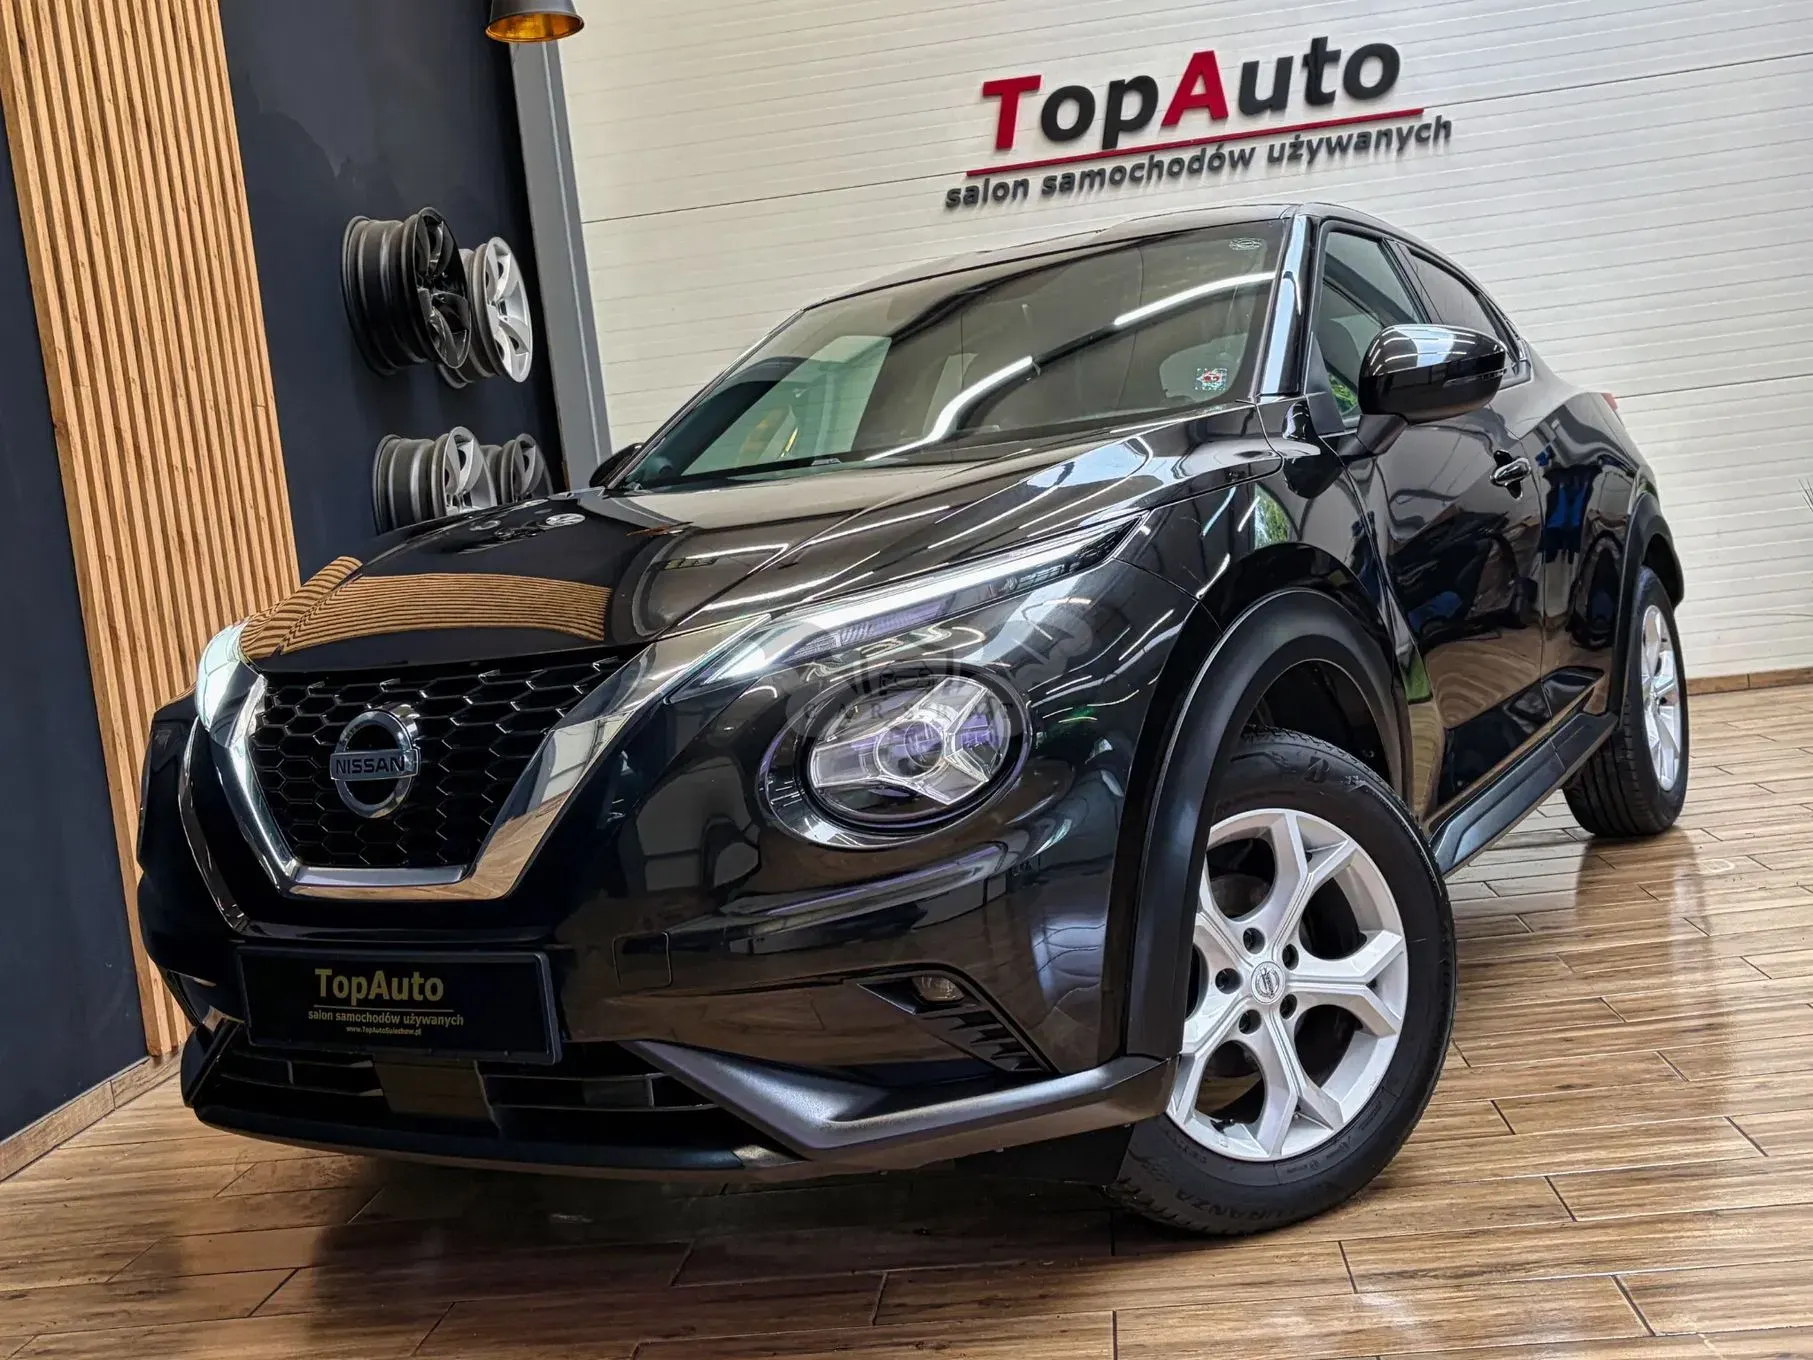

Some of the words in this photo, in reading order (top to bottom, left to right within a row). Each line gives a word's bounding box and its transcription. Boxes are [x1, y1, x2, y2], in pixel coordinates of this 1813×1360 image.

[982, 36, 1401, 151] TopAuto
[945, 177, 1030, 209] salon
[1041, 144, 1257, 195] samochodów
[1267, 114, 1453, 164] używanych
[335, 756, 405, 774] NISSAN
[314, 967, 444, 1006] TopAuto
[308, 1009, 334, 1021] salon
[335, 1011, 400, 1025] samochodów
[403, 1014, 464, 1028] używanych
